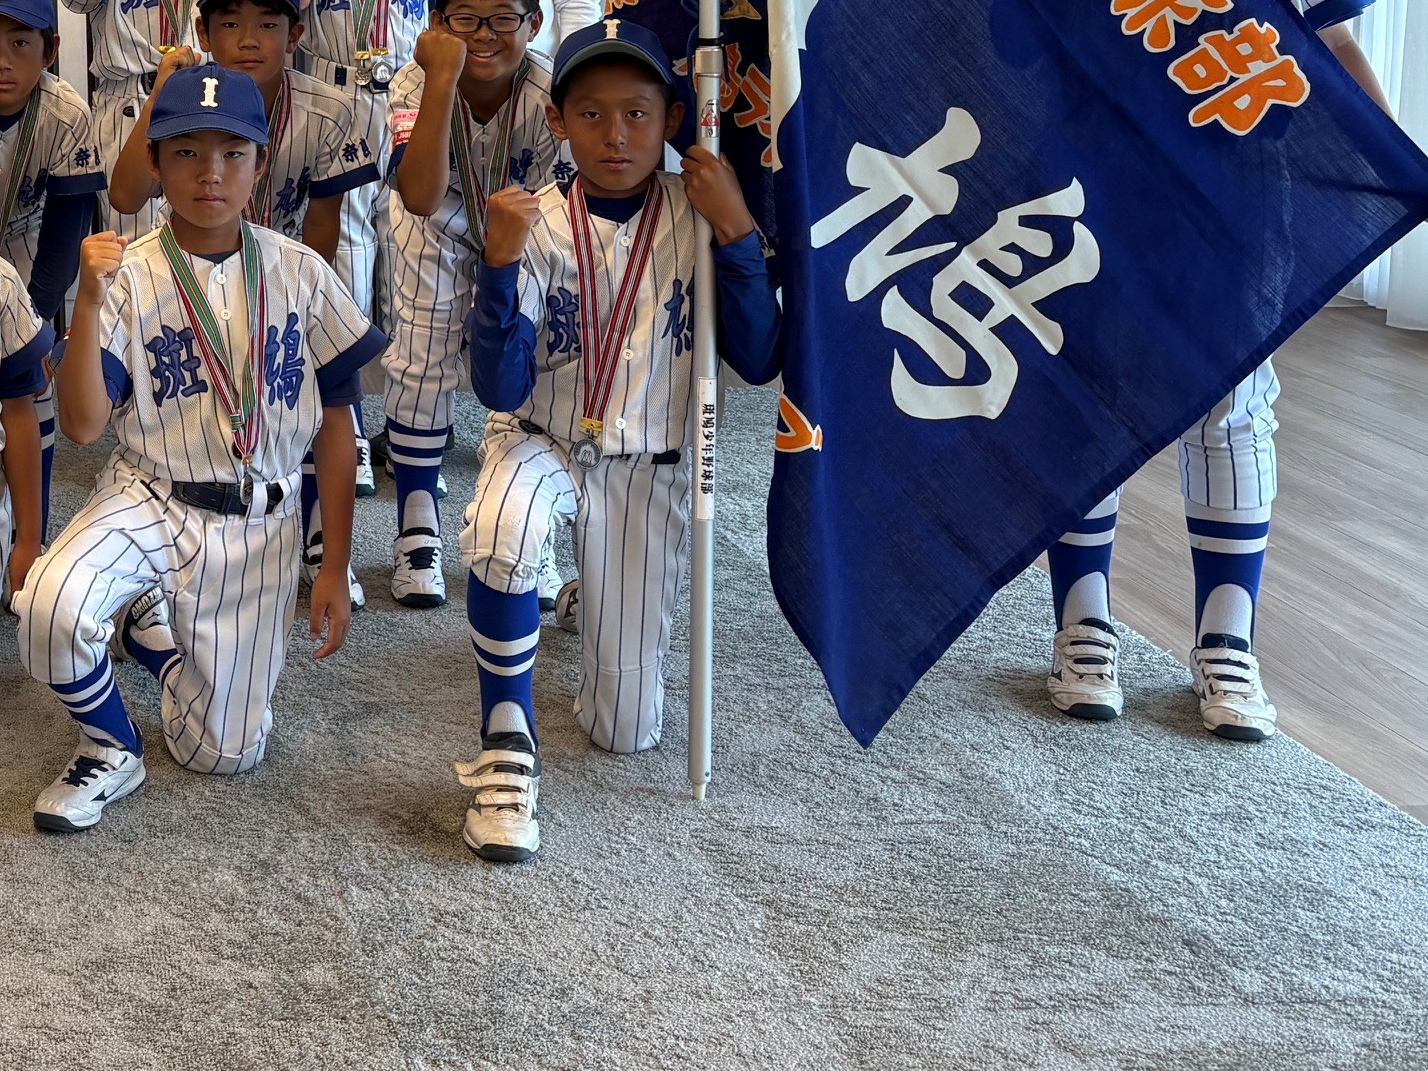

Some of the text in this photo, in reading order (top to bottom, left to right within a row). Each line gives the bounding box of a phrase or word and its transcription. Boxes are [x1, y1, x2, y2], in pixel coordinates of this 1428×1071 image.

[603, 18, 622, 39] I
[200, 76, 219, 107] I
[145, 312, 305, 411] 斑鳩
